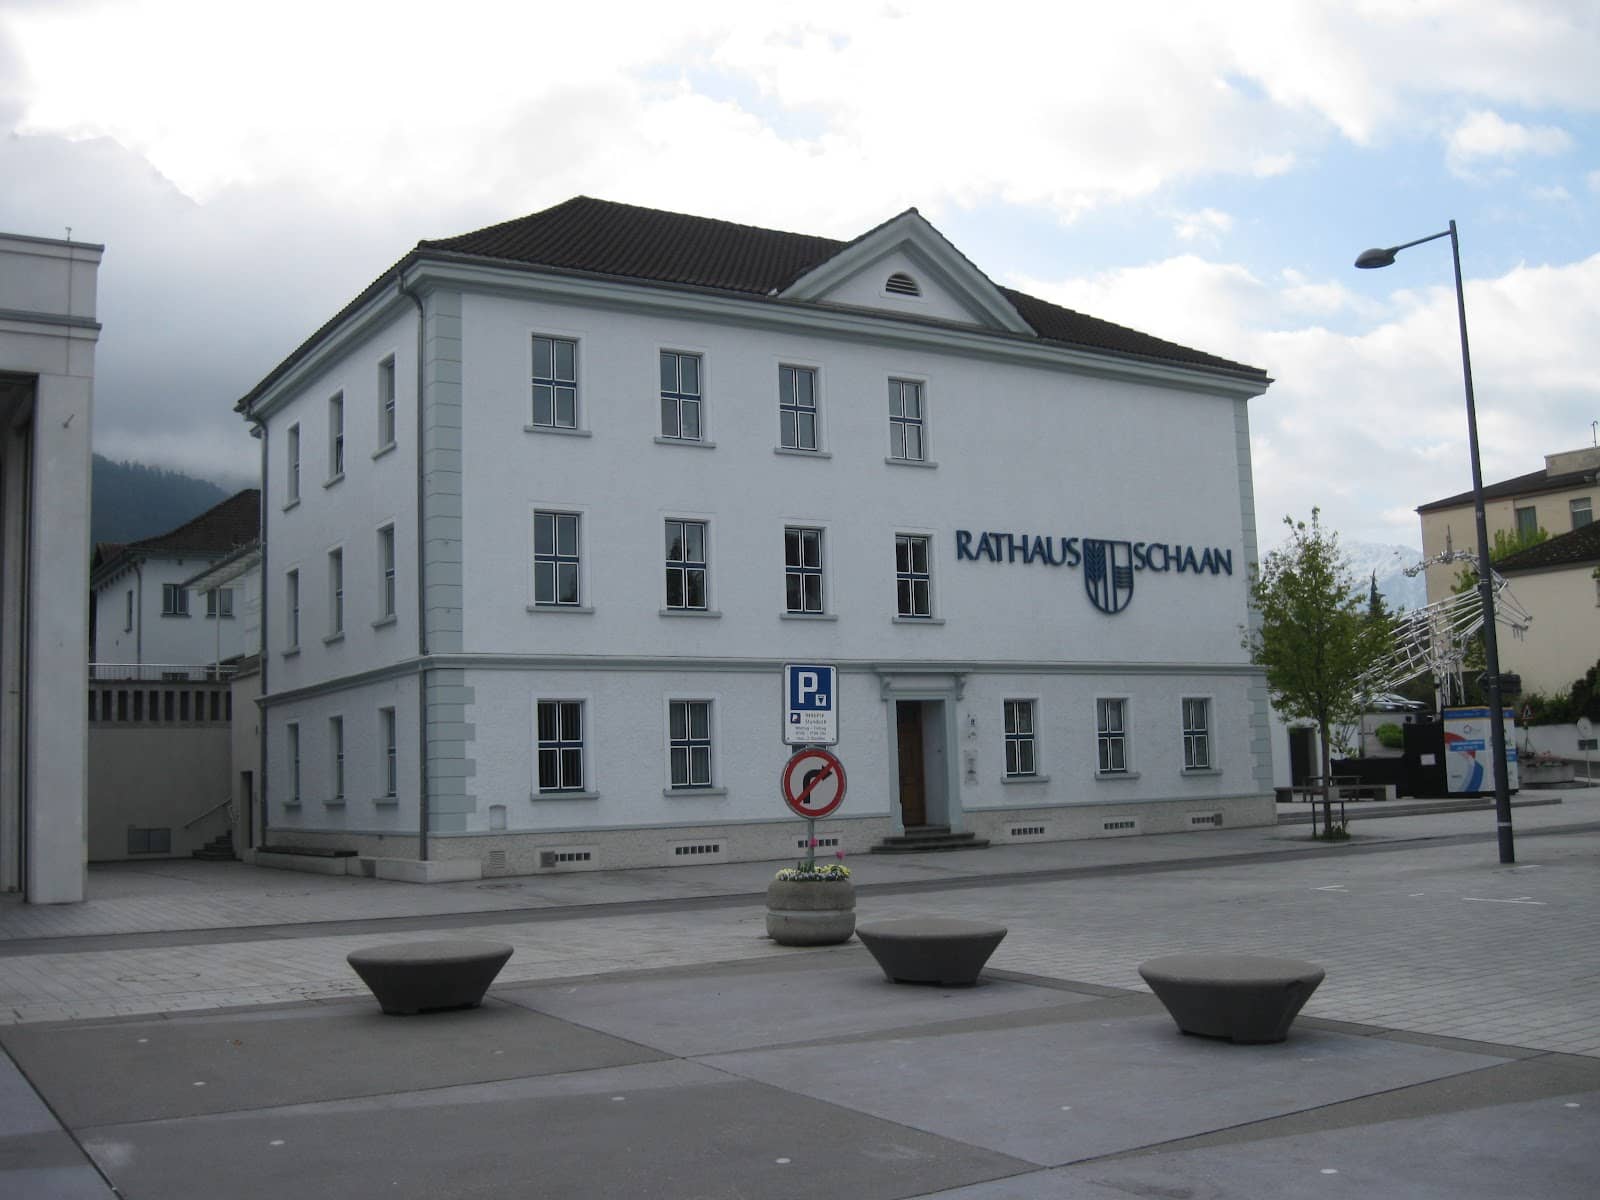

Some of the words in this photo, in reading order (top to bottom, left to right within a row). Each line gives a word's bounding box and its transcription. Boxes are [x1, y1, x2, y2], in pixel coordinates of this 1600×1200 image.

[955, 530, 1082, 567] RATHAUS
[1133, 542, 1233, 576] SCHAAN
[798, 671, 818, 704] P
